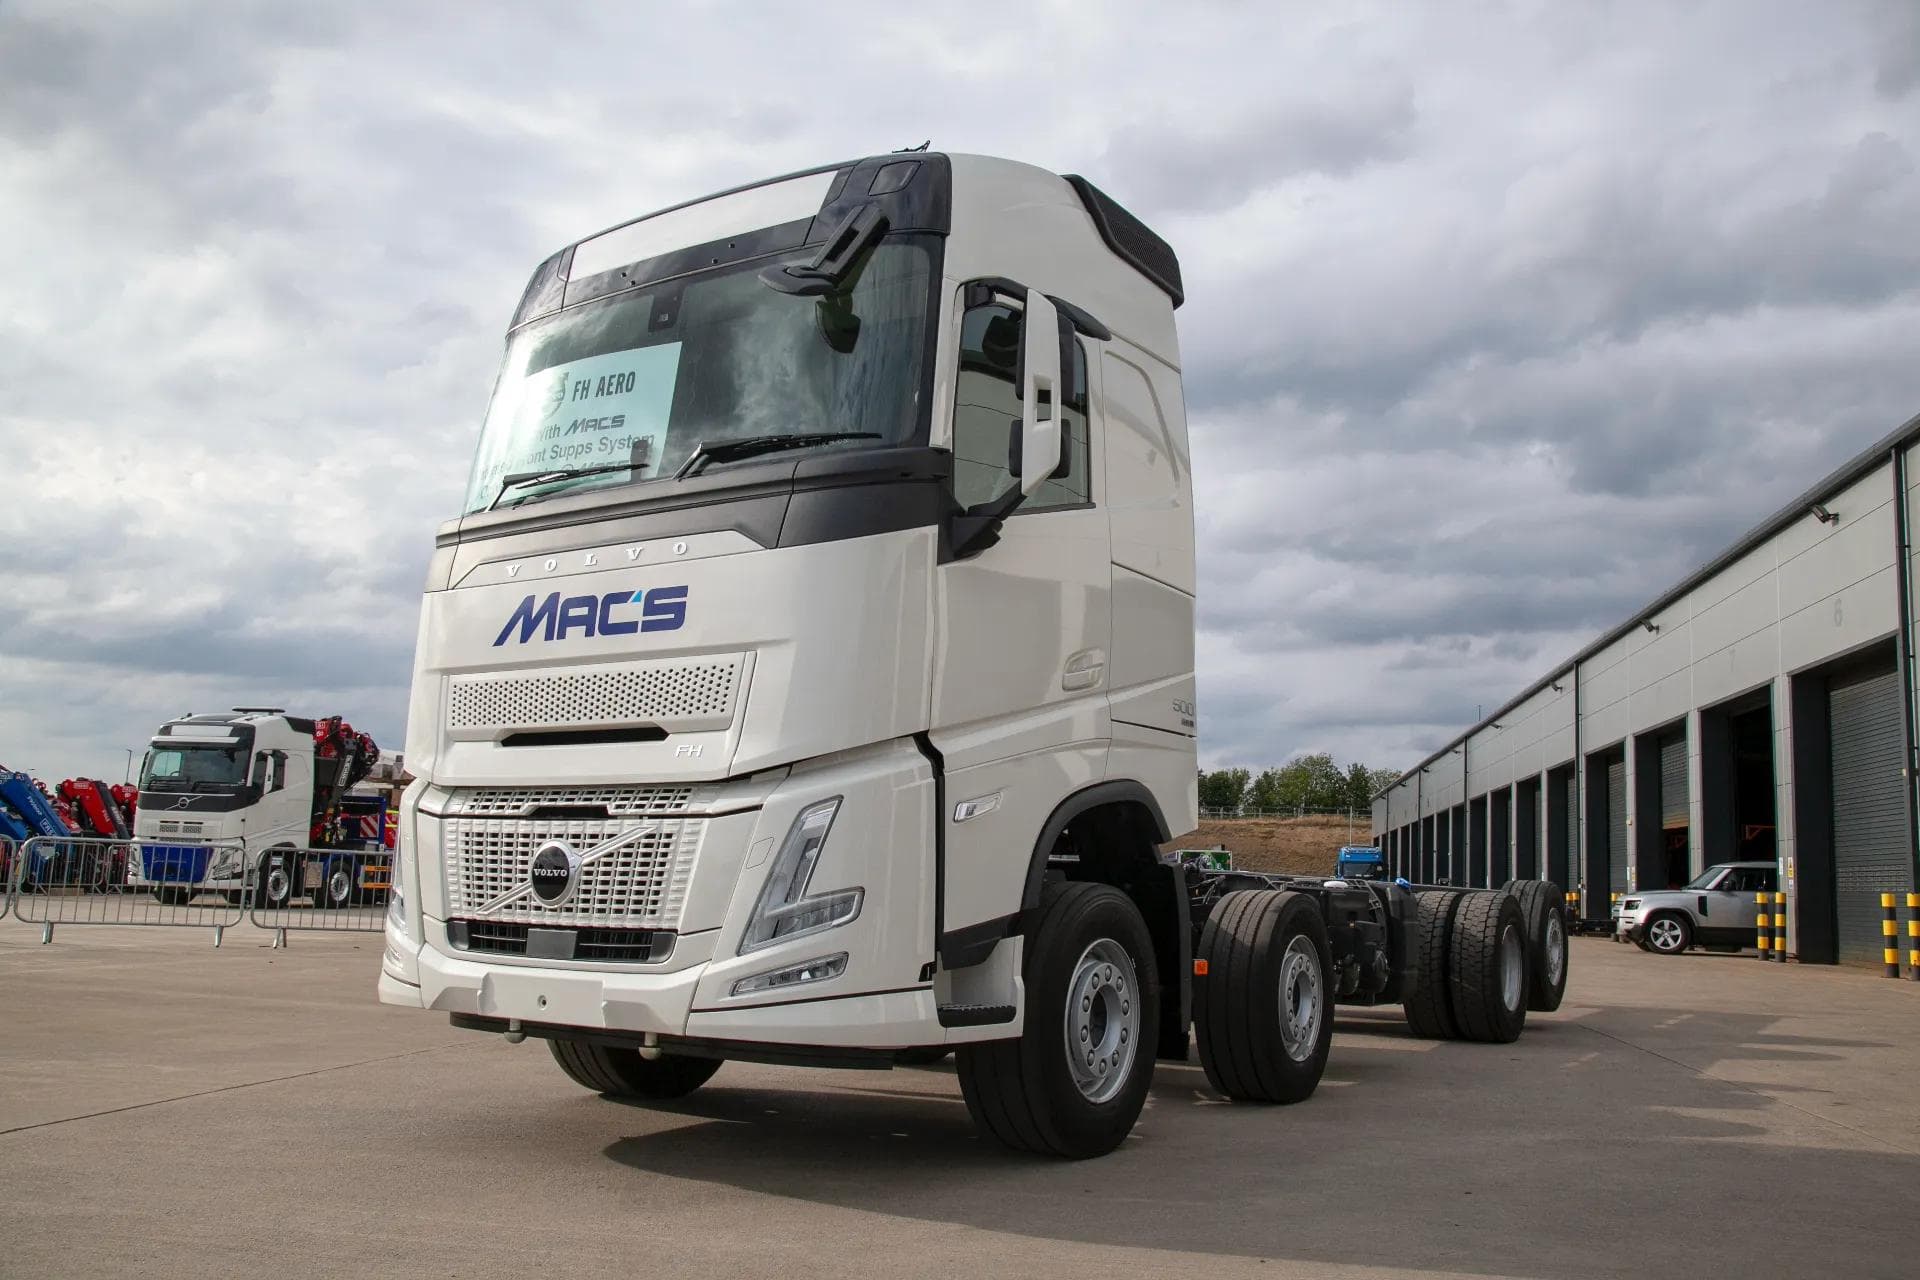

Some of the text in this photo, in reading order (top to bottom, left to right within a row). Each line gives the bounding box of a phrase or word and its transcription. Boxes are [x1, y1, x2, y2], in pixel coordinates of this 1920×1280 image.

[572, 371, 636, 401] FH AERO
[550, 441, 593, 462] Supps
[675, 744, 704, 758] FH
[533, 868, 568, 877] VOLVO
